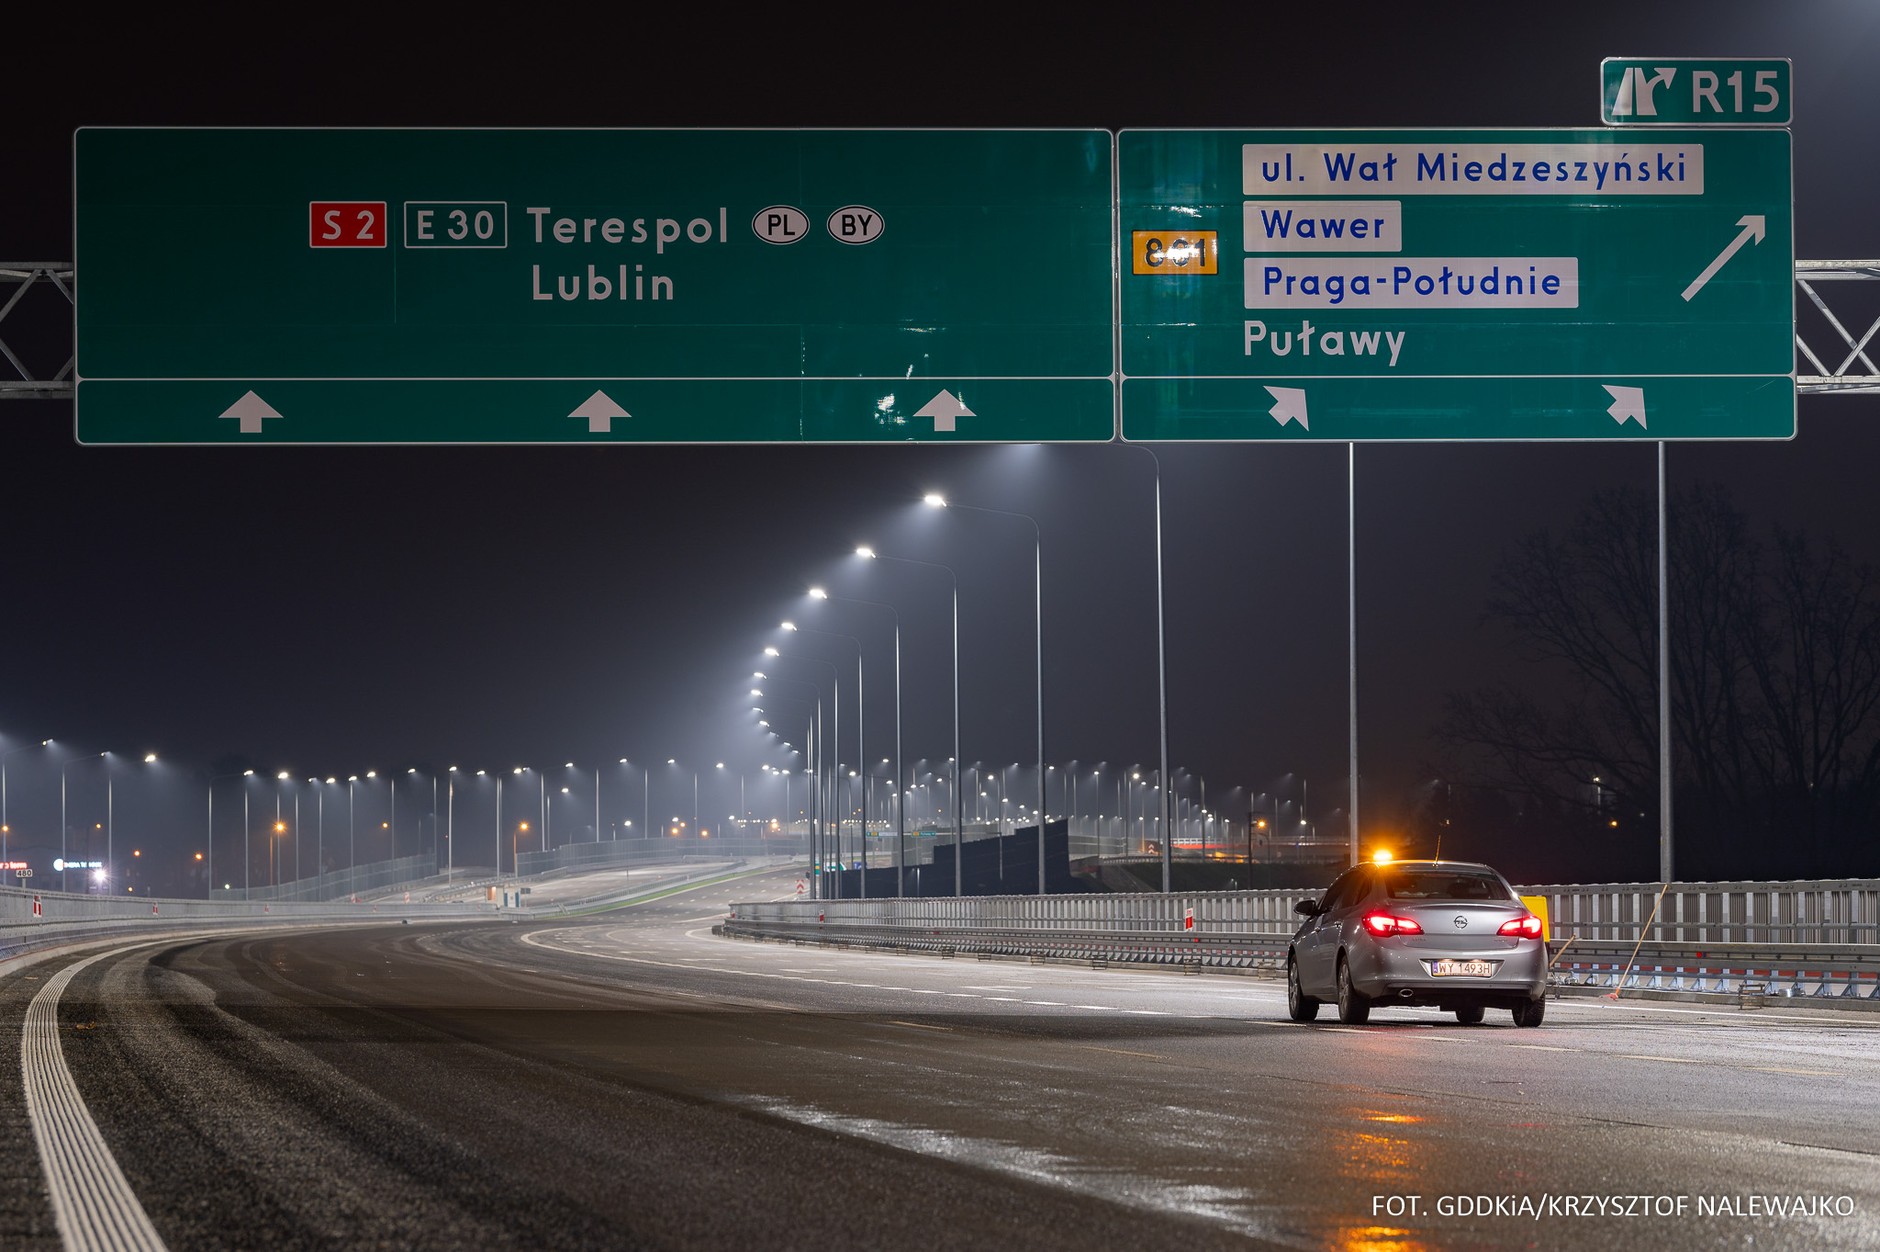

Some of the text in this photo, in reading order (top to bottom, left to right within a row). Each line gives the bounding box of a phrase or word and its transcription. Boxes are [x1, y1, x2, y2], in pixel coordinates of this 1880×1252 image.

[1692, 70, 1779, 113] R15
[1262, 152, 1685, 191] ul. Wał Miedzeszyński
[322, 210, 375, 240] S 2
[417, 209, 494, 240] E 30
[526, 207, 727, 254] Terespol
[767, 213, 796, 236] PL
[841, 214, 873, 236] BY
[1260, 209, 1385, 240] Wawer
[532, 264, 674, 301] Lublin
[1264, 266, 1561, 305] Praga-Południe
[1244, 320, 1406, 367] Puławy
